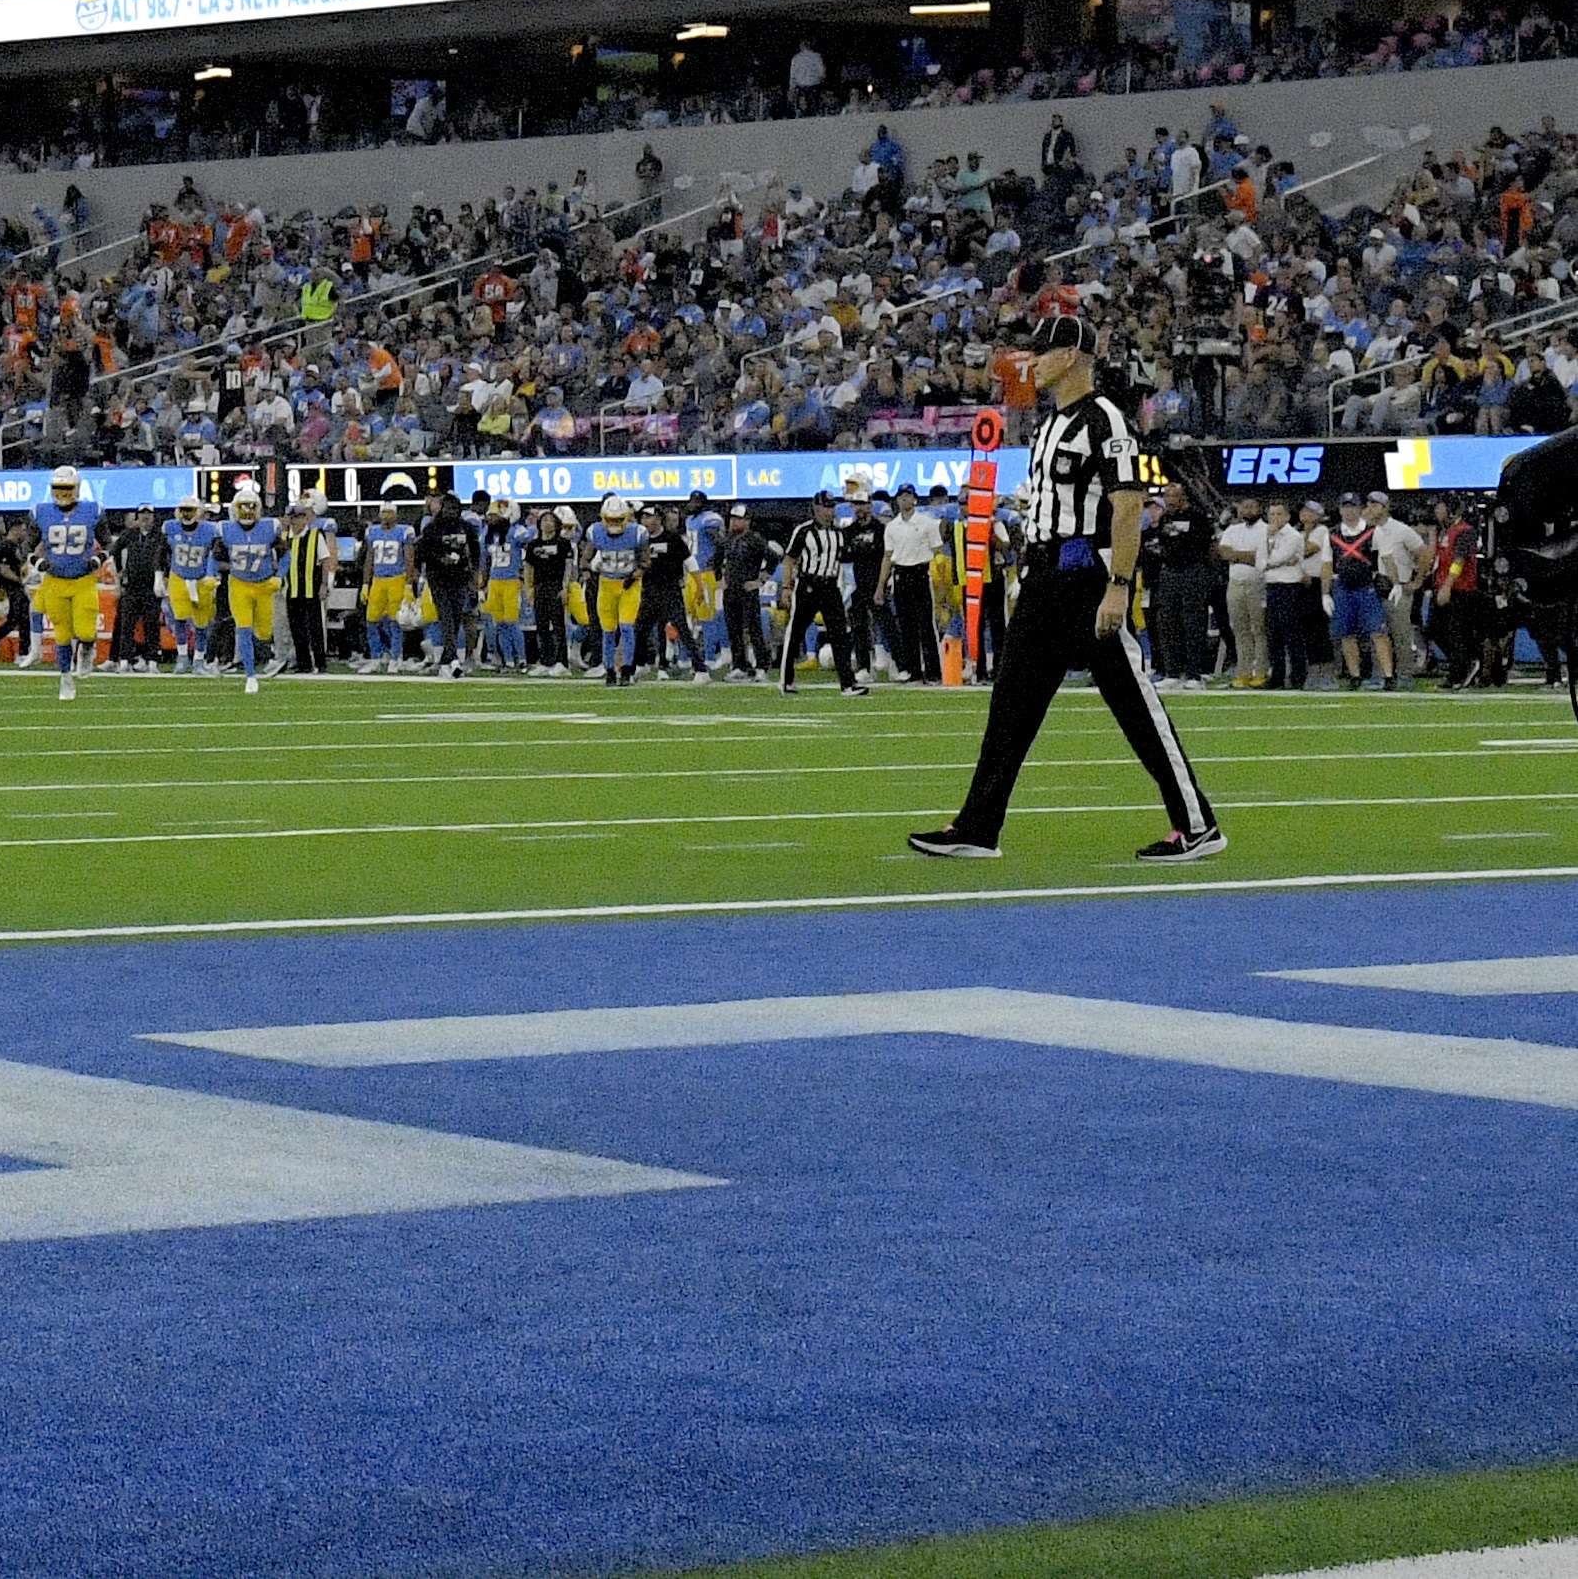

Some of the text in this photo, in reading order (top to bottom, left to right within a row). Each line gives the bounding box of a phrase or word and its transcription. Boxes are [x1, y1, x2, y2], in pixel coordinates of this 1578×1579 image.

[1109, 438, 1134, 454] 67
[473, 466, 572, 495] 1st & 10
[593, 468, 716, 490] BALL ON 39
[747, 469, 781, 487] LAC
[47, 524, 88, 556] 93
[231, 543, 268, 572] 57
